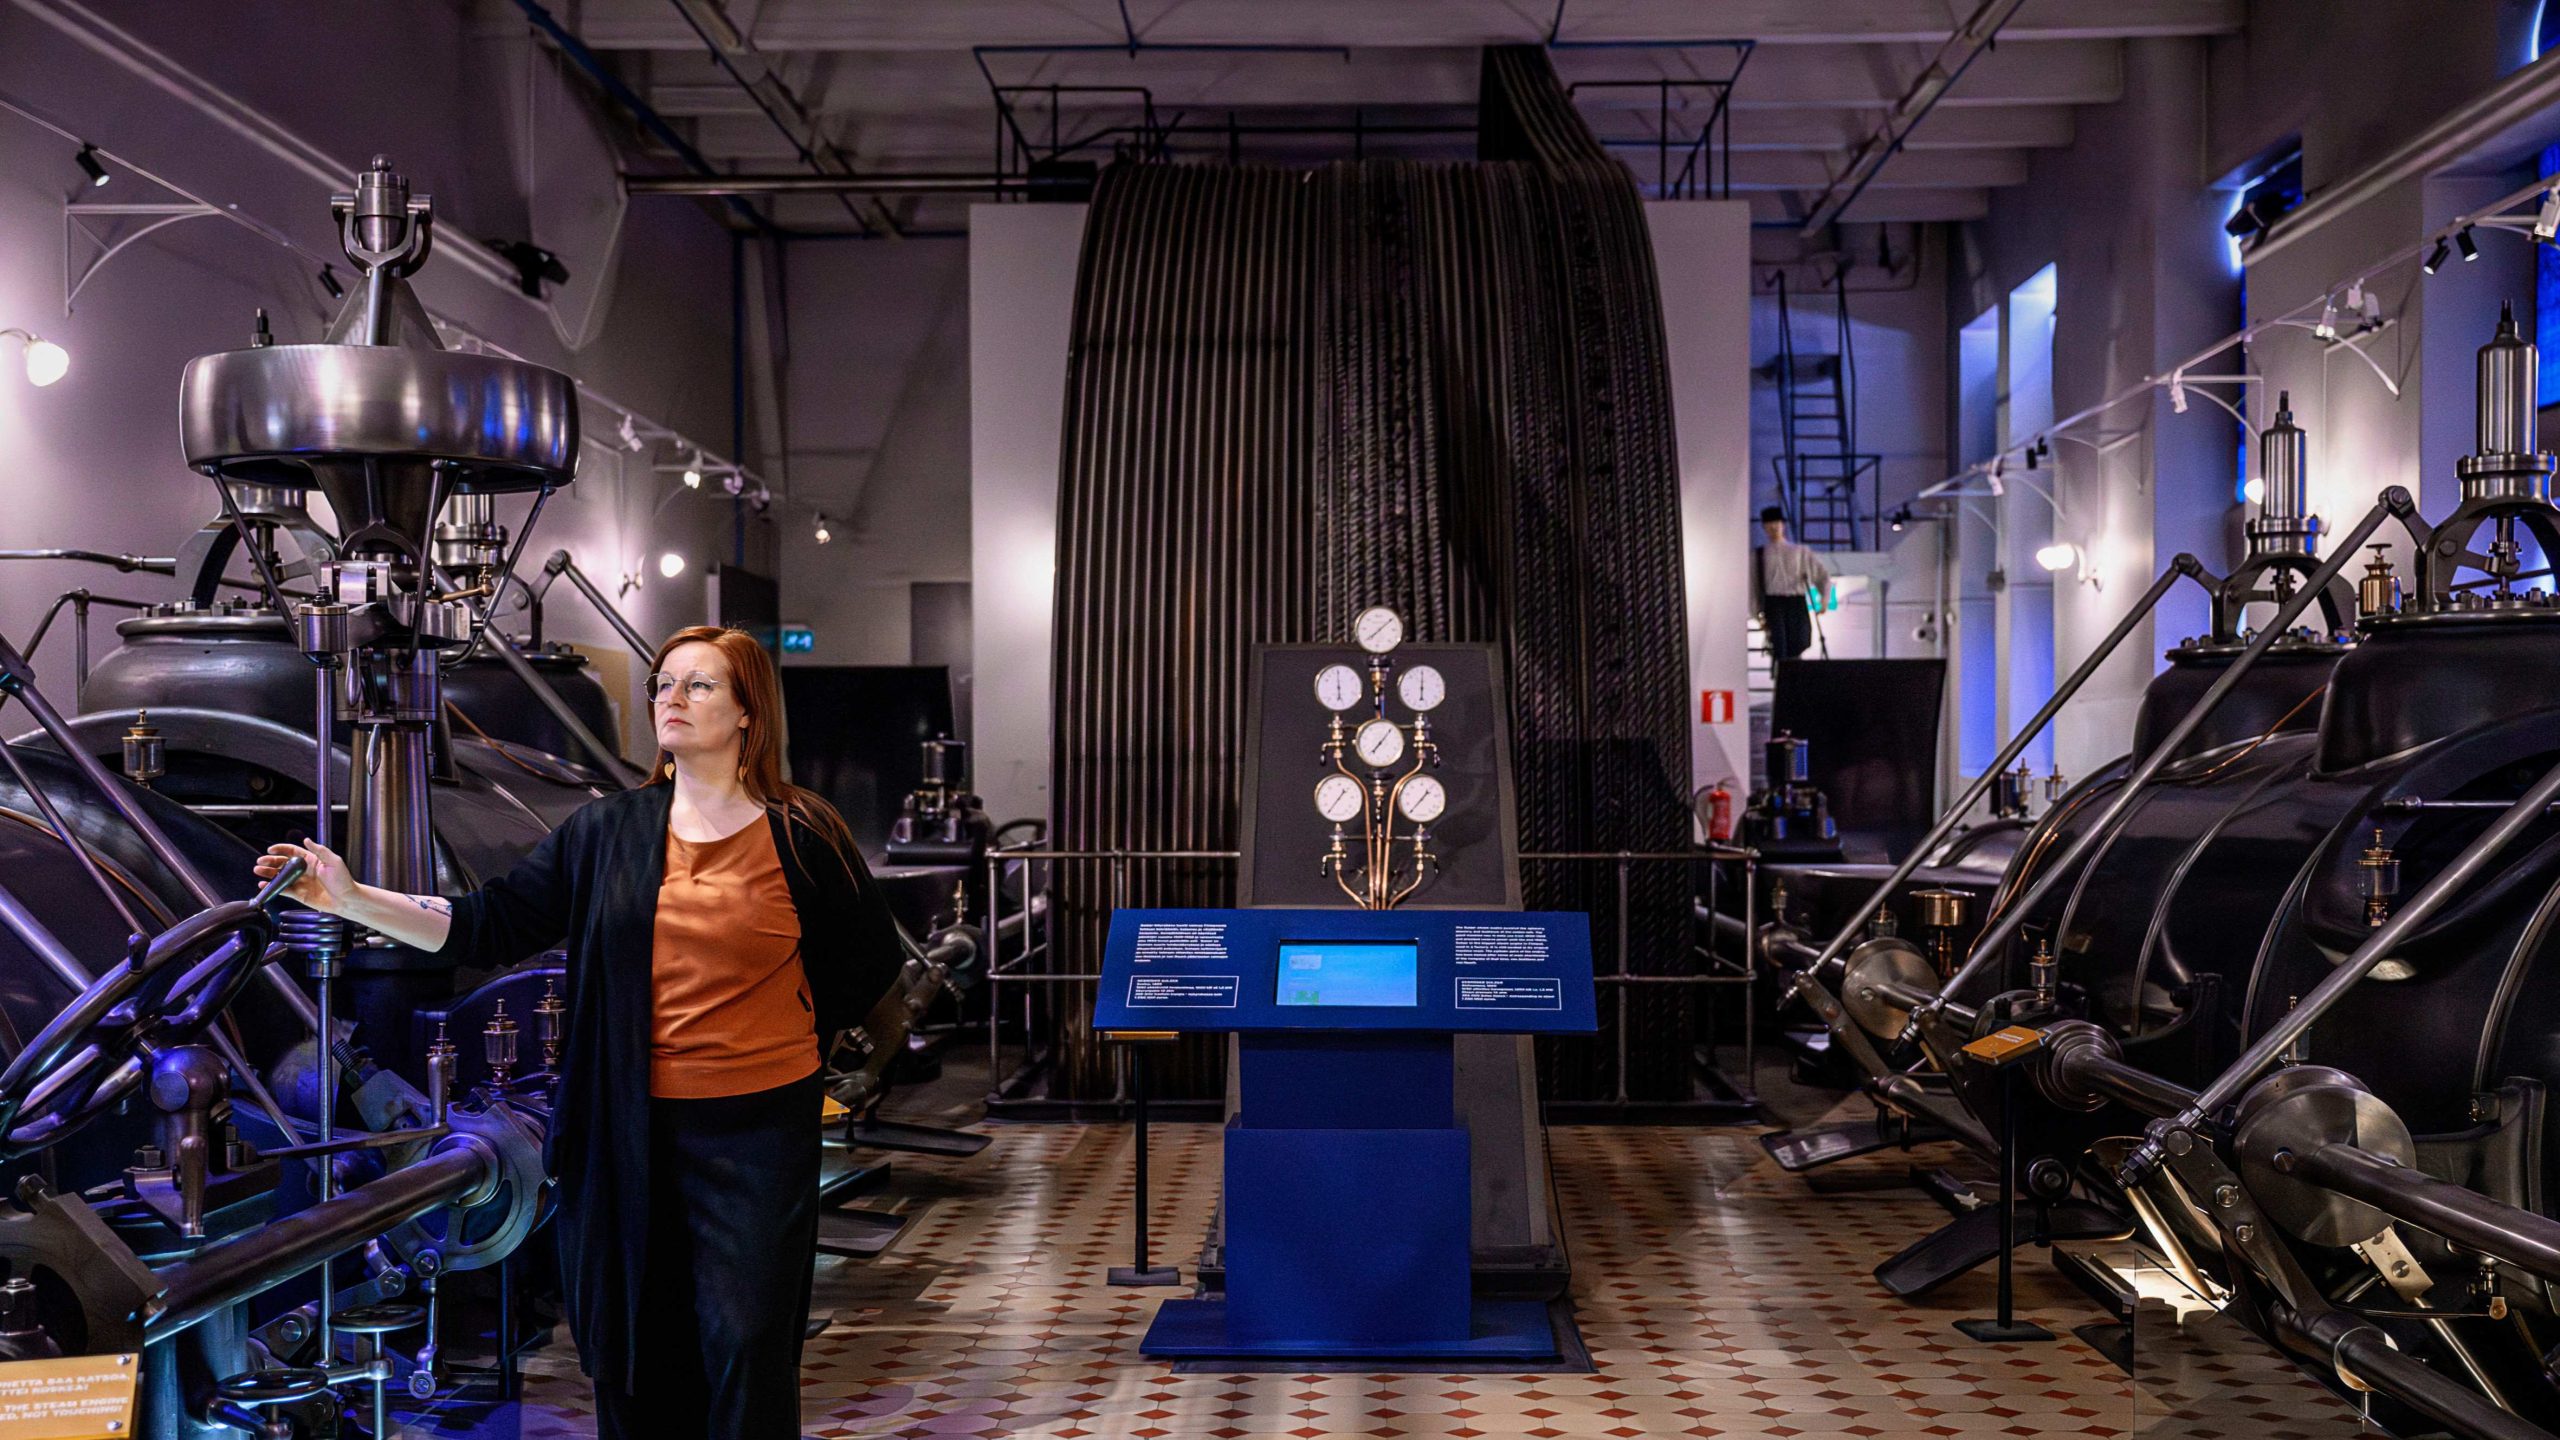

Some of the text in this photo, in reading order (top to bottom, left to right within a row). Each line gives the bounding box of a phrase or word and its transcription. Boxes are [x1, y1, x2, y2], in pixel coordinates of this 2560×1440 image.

[48, 1377, 73, 1385] SAA
[4, 1397, 128, 1412] THE STEAM ENGINE
[23, 1411, 47, 1420] NOT
